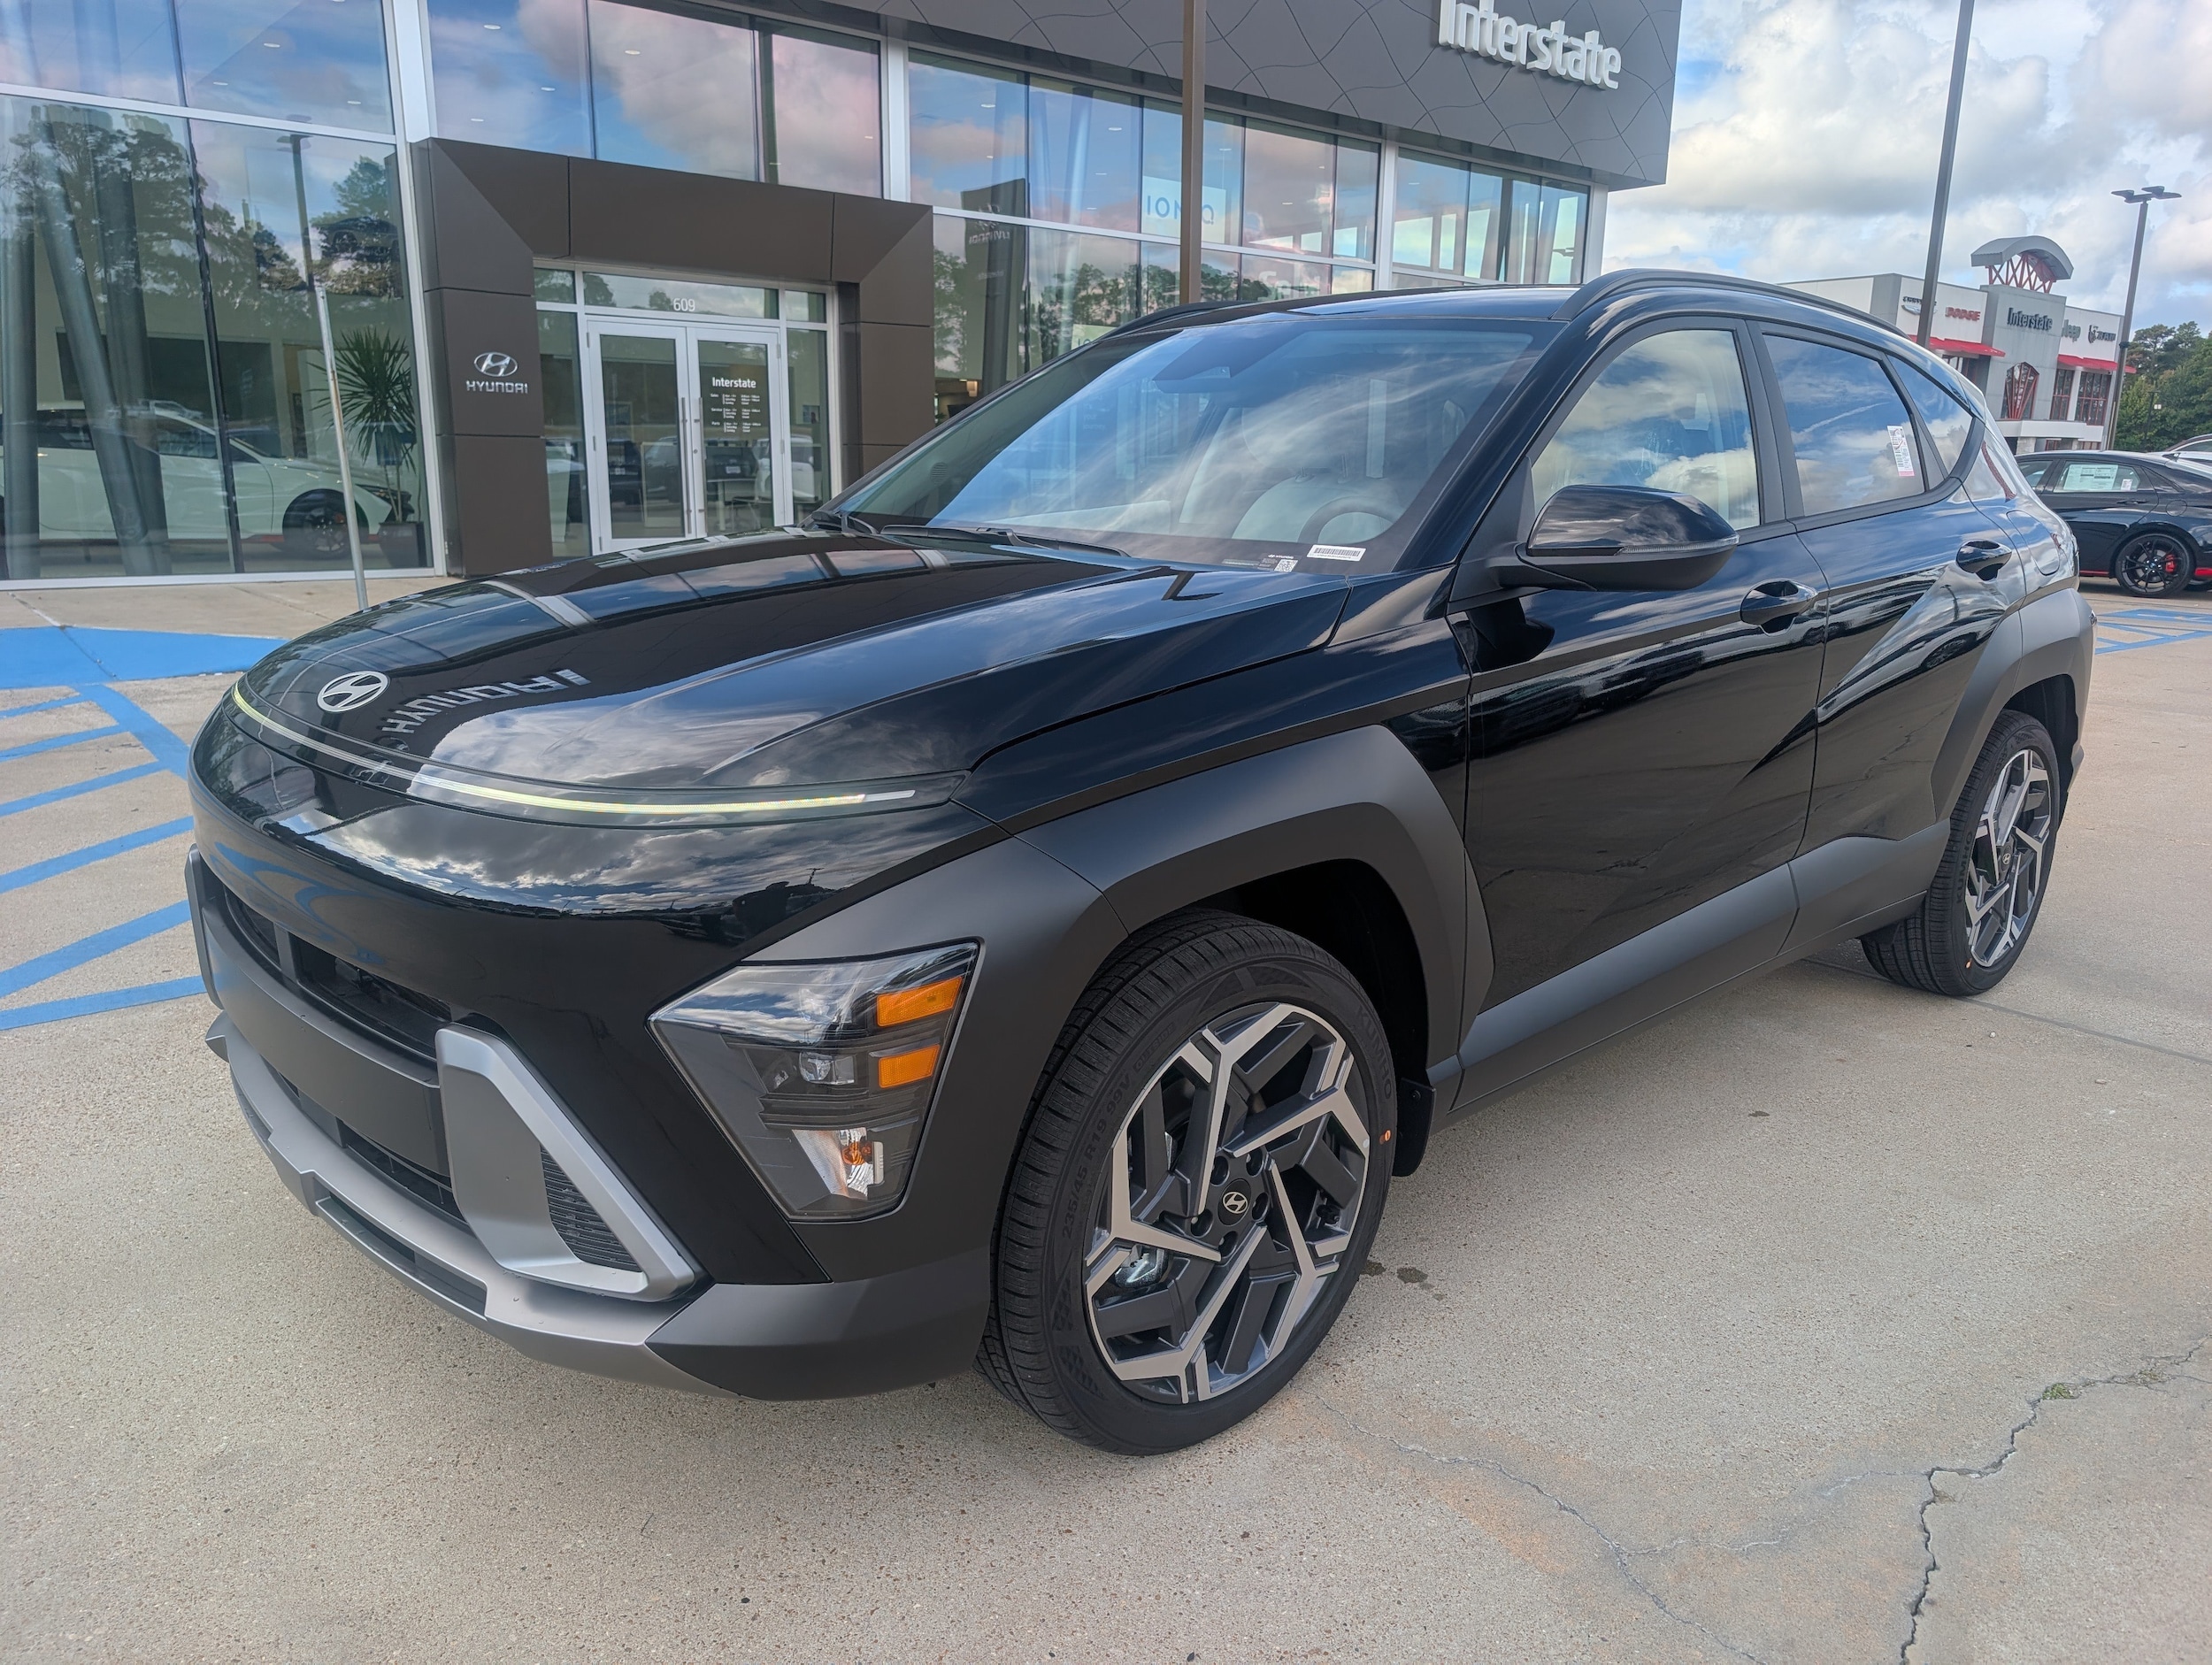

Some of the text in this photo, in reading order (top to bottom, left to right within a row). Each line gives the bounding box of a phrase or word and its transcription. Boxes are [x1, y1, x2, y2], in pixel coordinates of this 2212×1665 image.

[1439, 0, 1621, 89] Interstate
[1147, 195, 1214, 226] IOQ
[673, 298, 695, 311] 609
[1945, 307, 1981, 321] DODGE
[2007, 307, 2053, 332] Interstate
[465, 380, 528, 394] HYUNDAI
[711, 376, 757, 388] Interstate
[1356, 1005, 1393, 1100] KUMHO
[1061, 1072, 1133, 1239] 235/45 R19 99V
